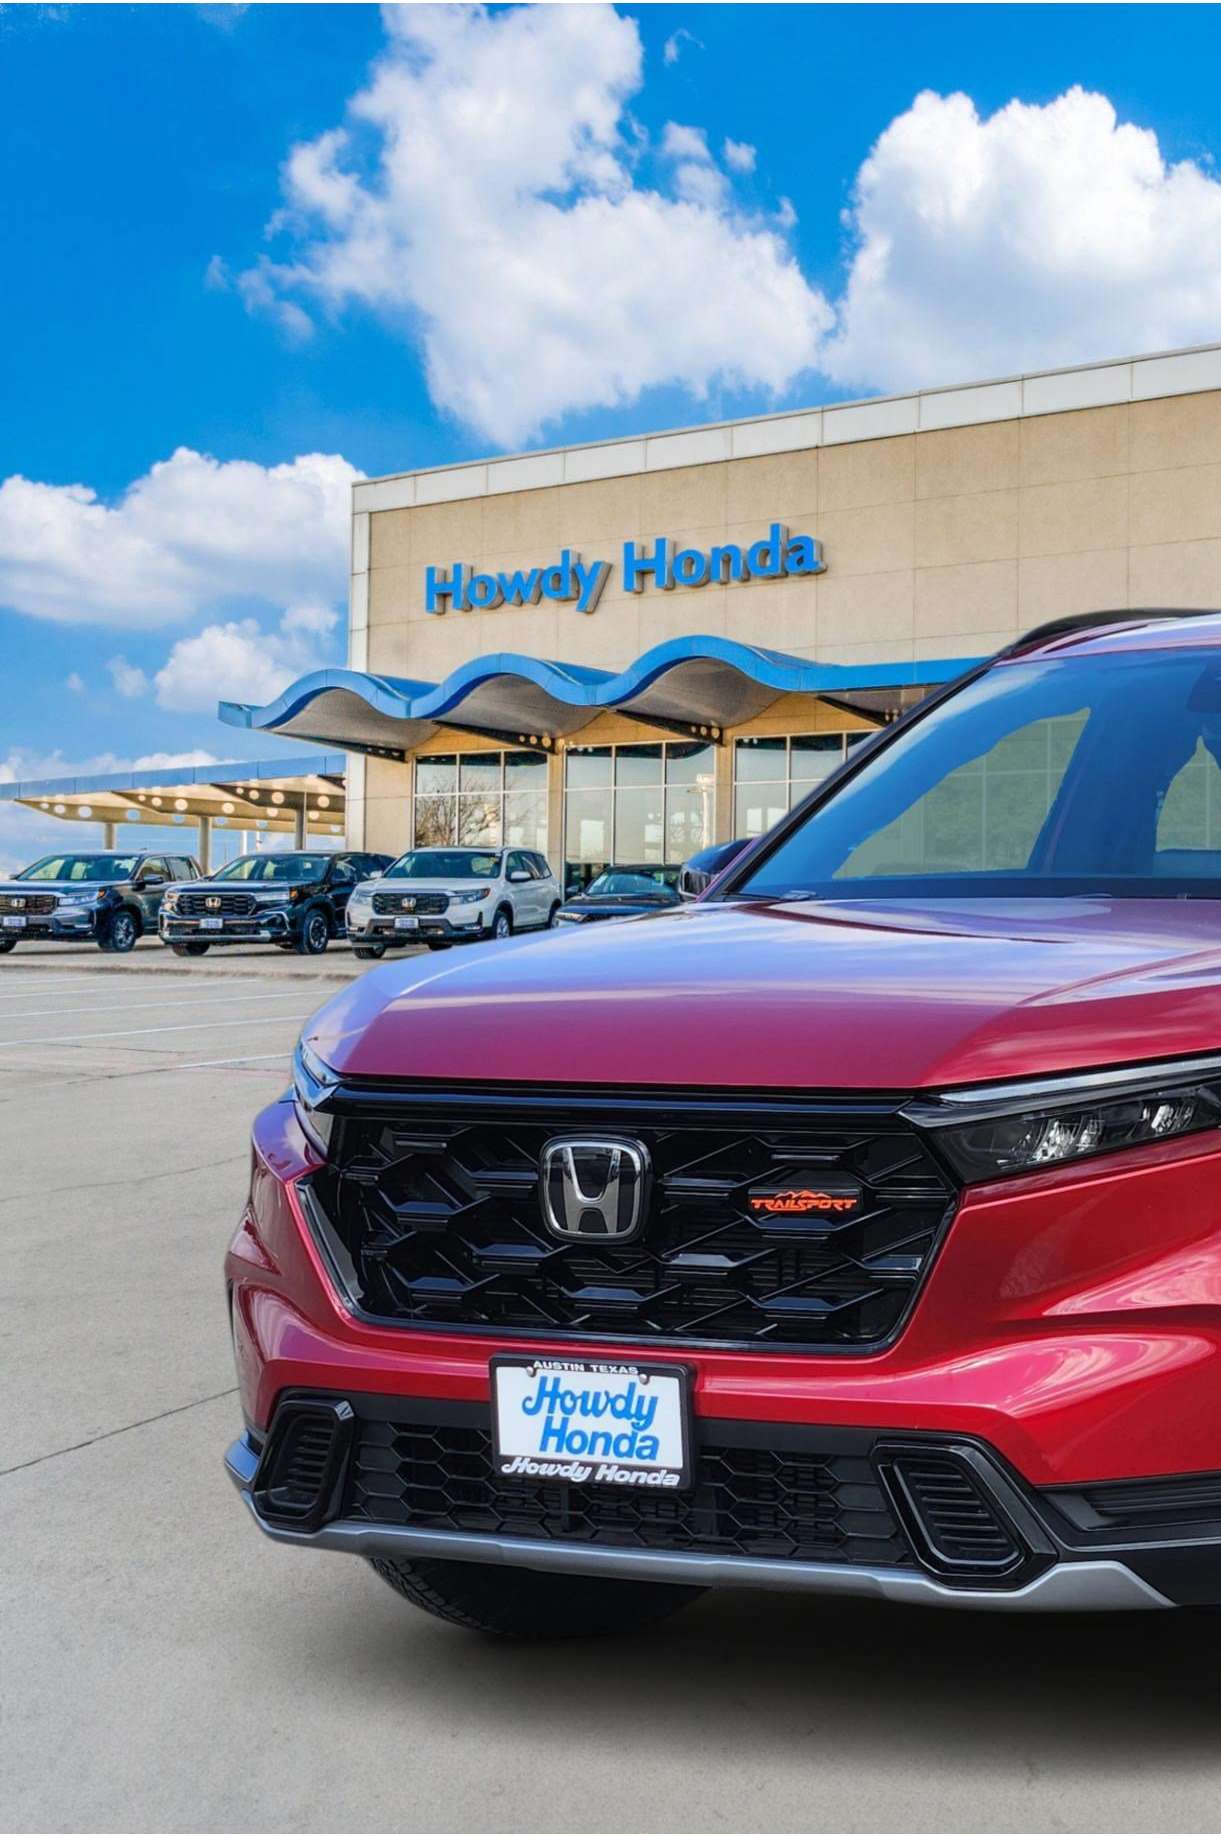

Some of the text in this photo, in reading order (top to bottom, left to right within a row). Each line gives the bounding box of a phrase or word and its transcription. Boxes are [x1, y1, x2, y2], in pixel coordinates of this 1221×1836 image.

[425, 522, 827, 615] Howdy Honda
[751, 1199, 857, 1211] TRAILSPORT
[532, 1360, 639, 1375] AUSTIN TEXAS
[522, 1375, 659, 1432] Howdy
[538, 1415, 660, 1461] Honda
[500, 1456, 681, 1487] Howdy Honda
